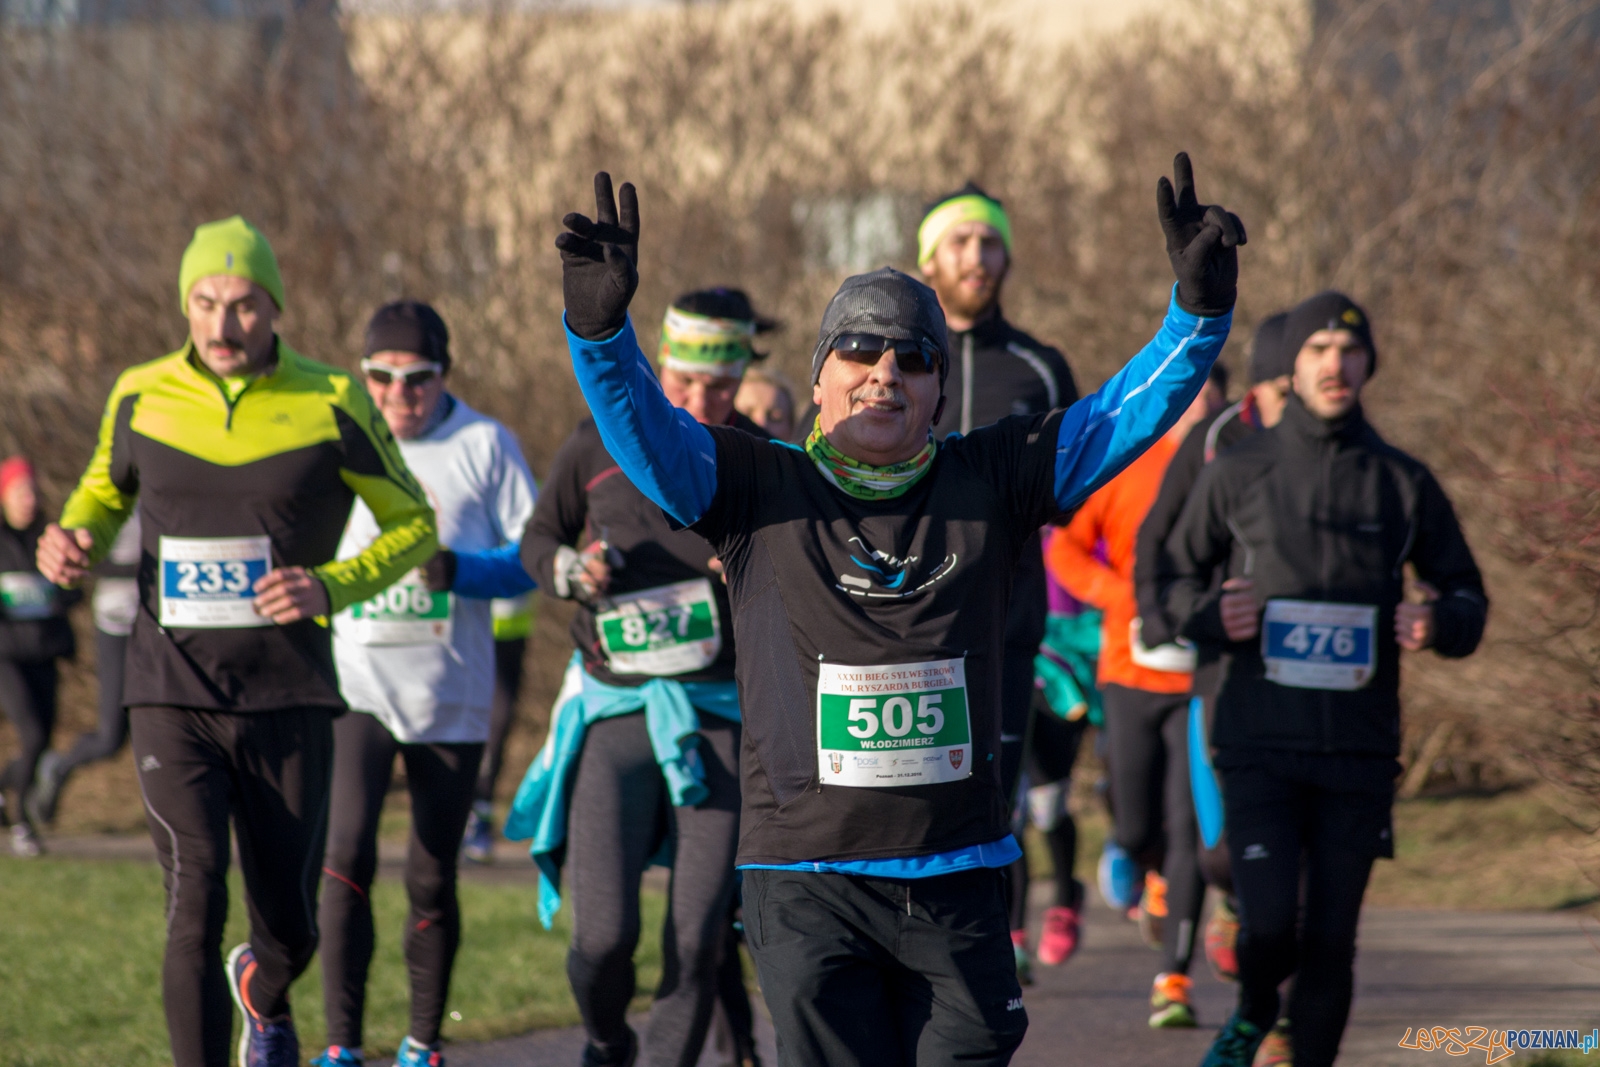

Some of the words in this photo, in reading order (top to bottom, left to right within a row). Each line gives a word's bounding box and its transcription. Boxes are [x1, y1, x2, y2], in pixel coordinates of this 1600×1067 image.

[176, 562, 250, 593] 233
[620, 604, 692, 646] 827
[1282, 624, 1355, 657] 476
[837, 672, 863, 682] XXXII
[865, 671, 889, 681] BIEG
[891, 666, 956, 680] SYLWESTROWY
[841, 684, 855, 692] IM.
[857, 681, 909, 693] RYSZARDA
[911, 677, 954, 689] BURGIELA
[847, 693, 945, 739] 505
[860, 736, 935, 749] WŁODZIMIERZ
